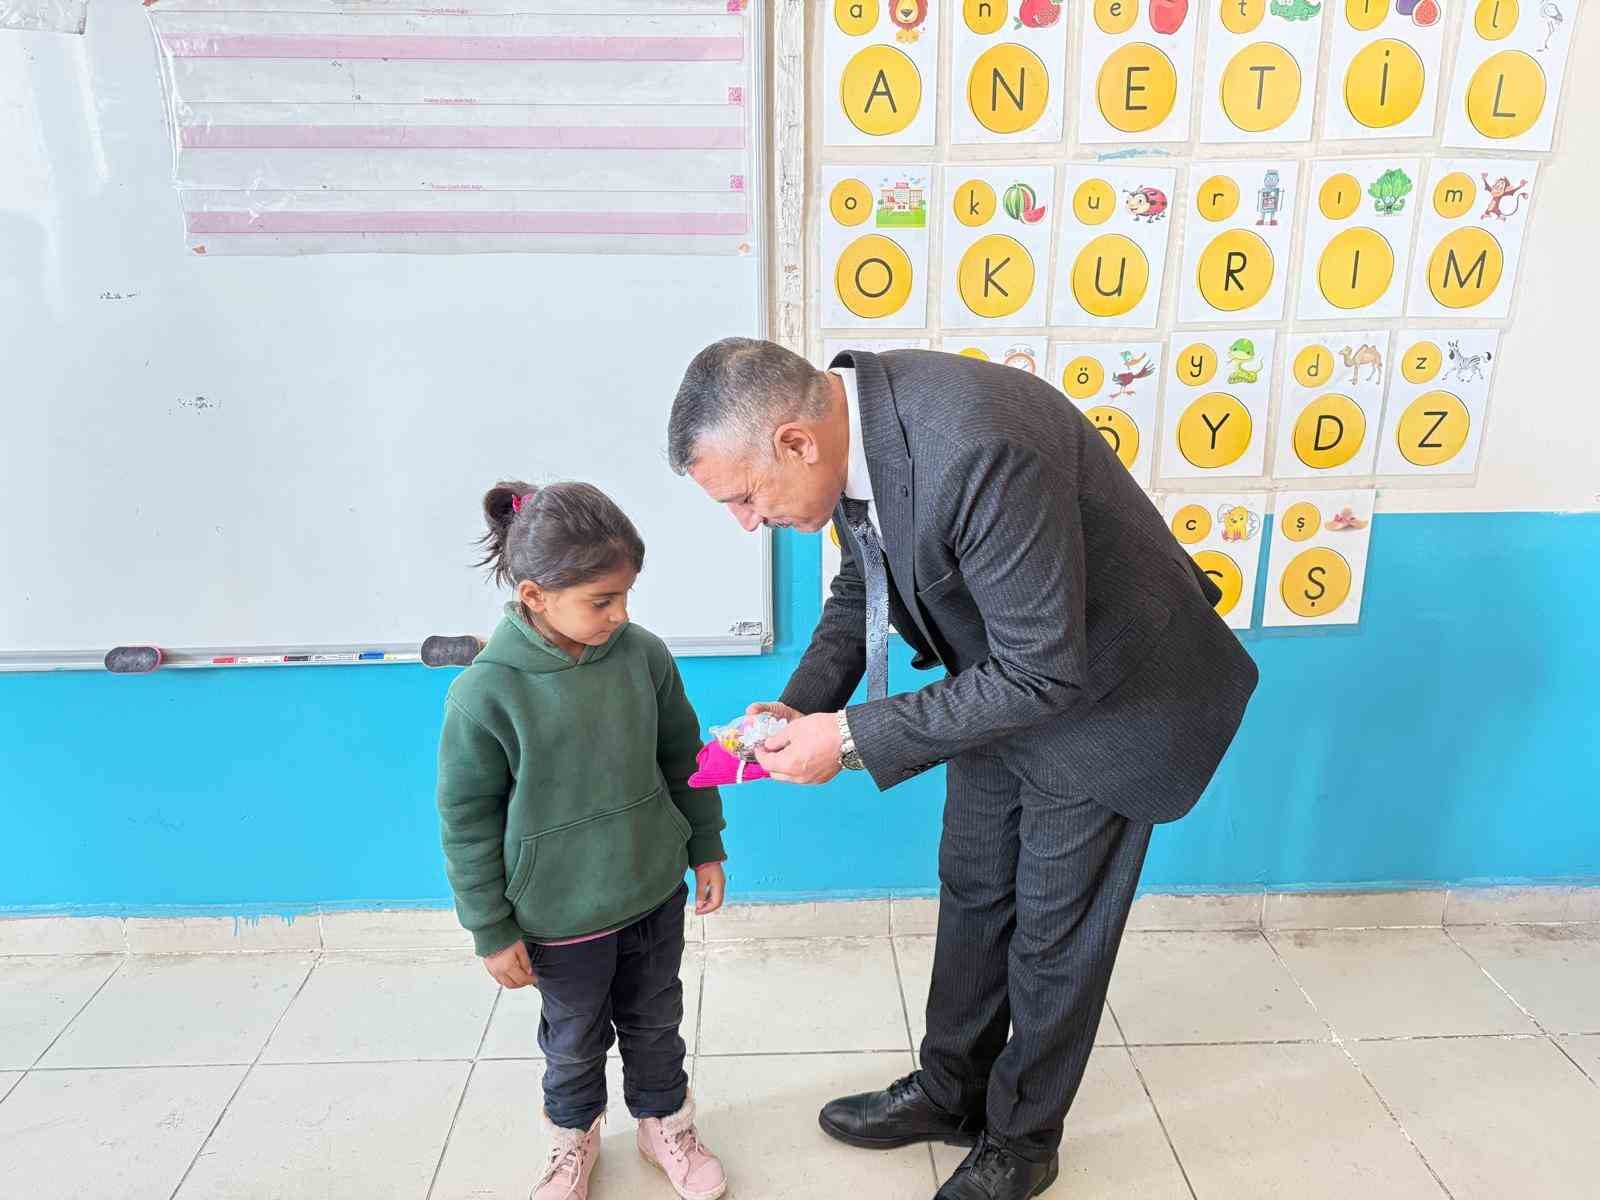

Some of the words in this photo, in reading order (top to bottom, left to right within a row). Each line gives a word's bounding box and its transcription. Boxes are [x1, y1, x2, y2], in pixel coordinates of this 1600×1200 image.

[850, 5, 862, 18] a
[980, 3, 991, 16] n
[1111, 3, 1122, 16] e
[1238, 0, 1247, 16] t
[864, 69, 897, 113] A
[992, 67, 1025, 111] N
[1125, 66, 1149, 110] E
[1249, 66, 1275, 109] T
[1379, 50, 1390, 106] İ
[1492, 74, 1516, 117] L
[845, 197, 857, 210] o
[970, 190, 979, 215] k
[1087, 197, 1100, 210] u
[1212, 192, 1224, 206] r
[1445, 190, 1463, 203] m
[855, 258, 893, 297] O
[984, 257, 1010, 297] K
[1095, 256, 1126, 297] U
[1224, 252, 1246, 291] R
[1443, 249, 1487, 289] M
[1077, 367, 1089, 384] ö
[1190, 356, 1203, 378] y
[1307, 354, 1320, 376] d
[1416, 357, 1427, 370] z
[1202, 413, 1230, 450] Y
[1313, 415, 1344, 450] D
[1418, 411, 1448, 448] Z
[1186, 519, 1197, 531] c
[1304, 567, 1326, 607] Ş
